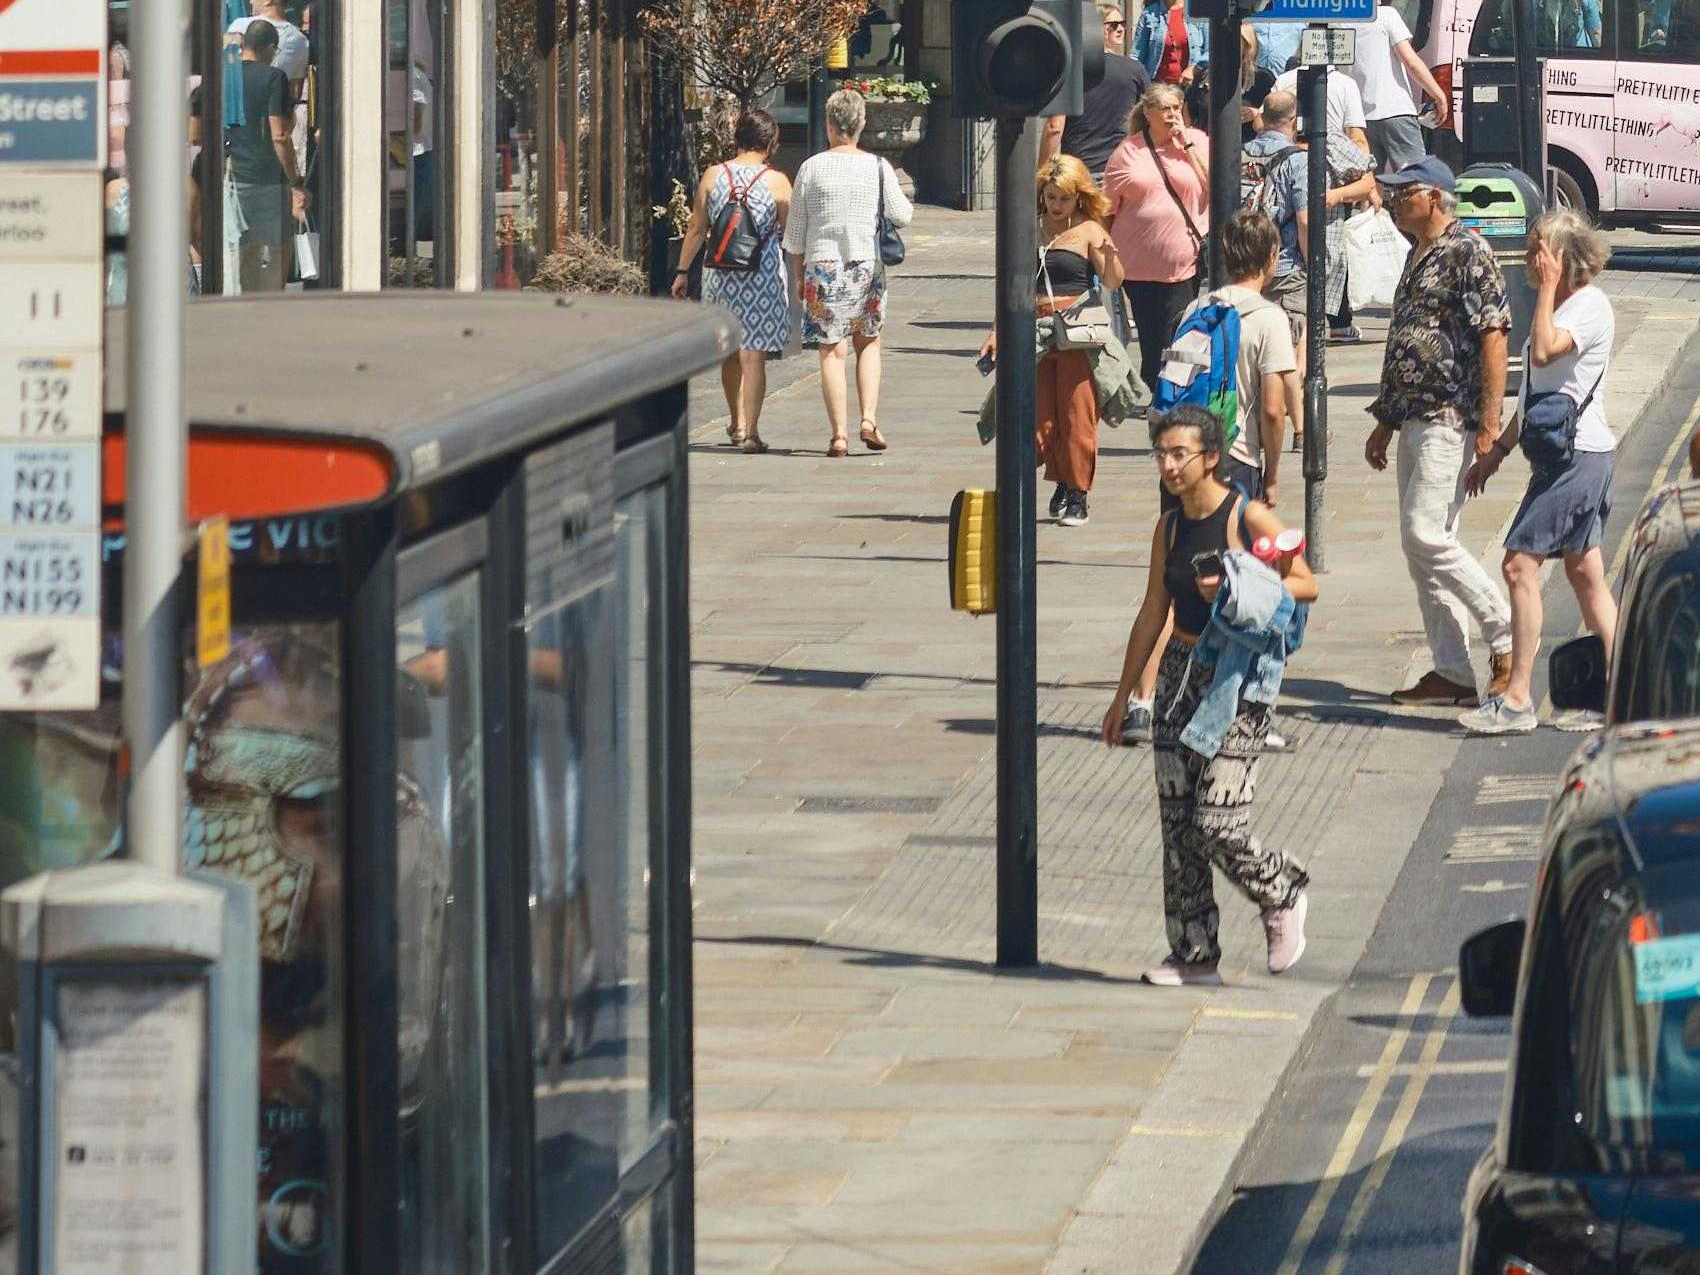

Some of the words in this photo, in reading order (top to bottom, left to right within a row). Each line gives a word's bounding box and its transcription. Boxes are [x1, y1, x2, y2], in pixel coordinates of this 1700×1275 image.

[1546, 108, 1655, 138] RETTYLITTLETHING
[29, 292, 62, 321] 11
[19, 377, 69, 402] 139
[19, 410, 69, 434] 176
[15, 468, 73, 493] N21
[13, 500, 73, 524] N26
[3, 557, 82, 583] N155
[3, 589, 82, 615] N199
